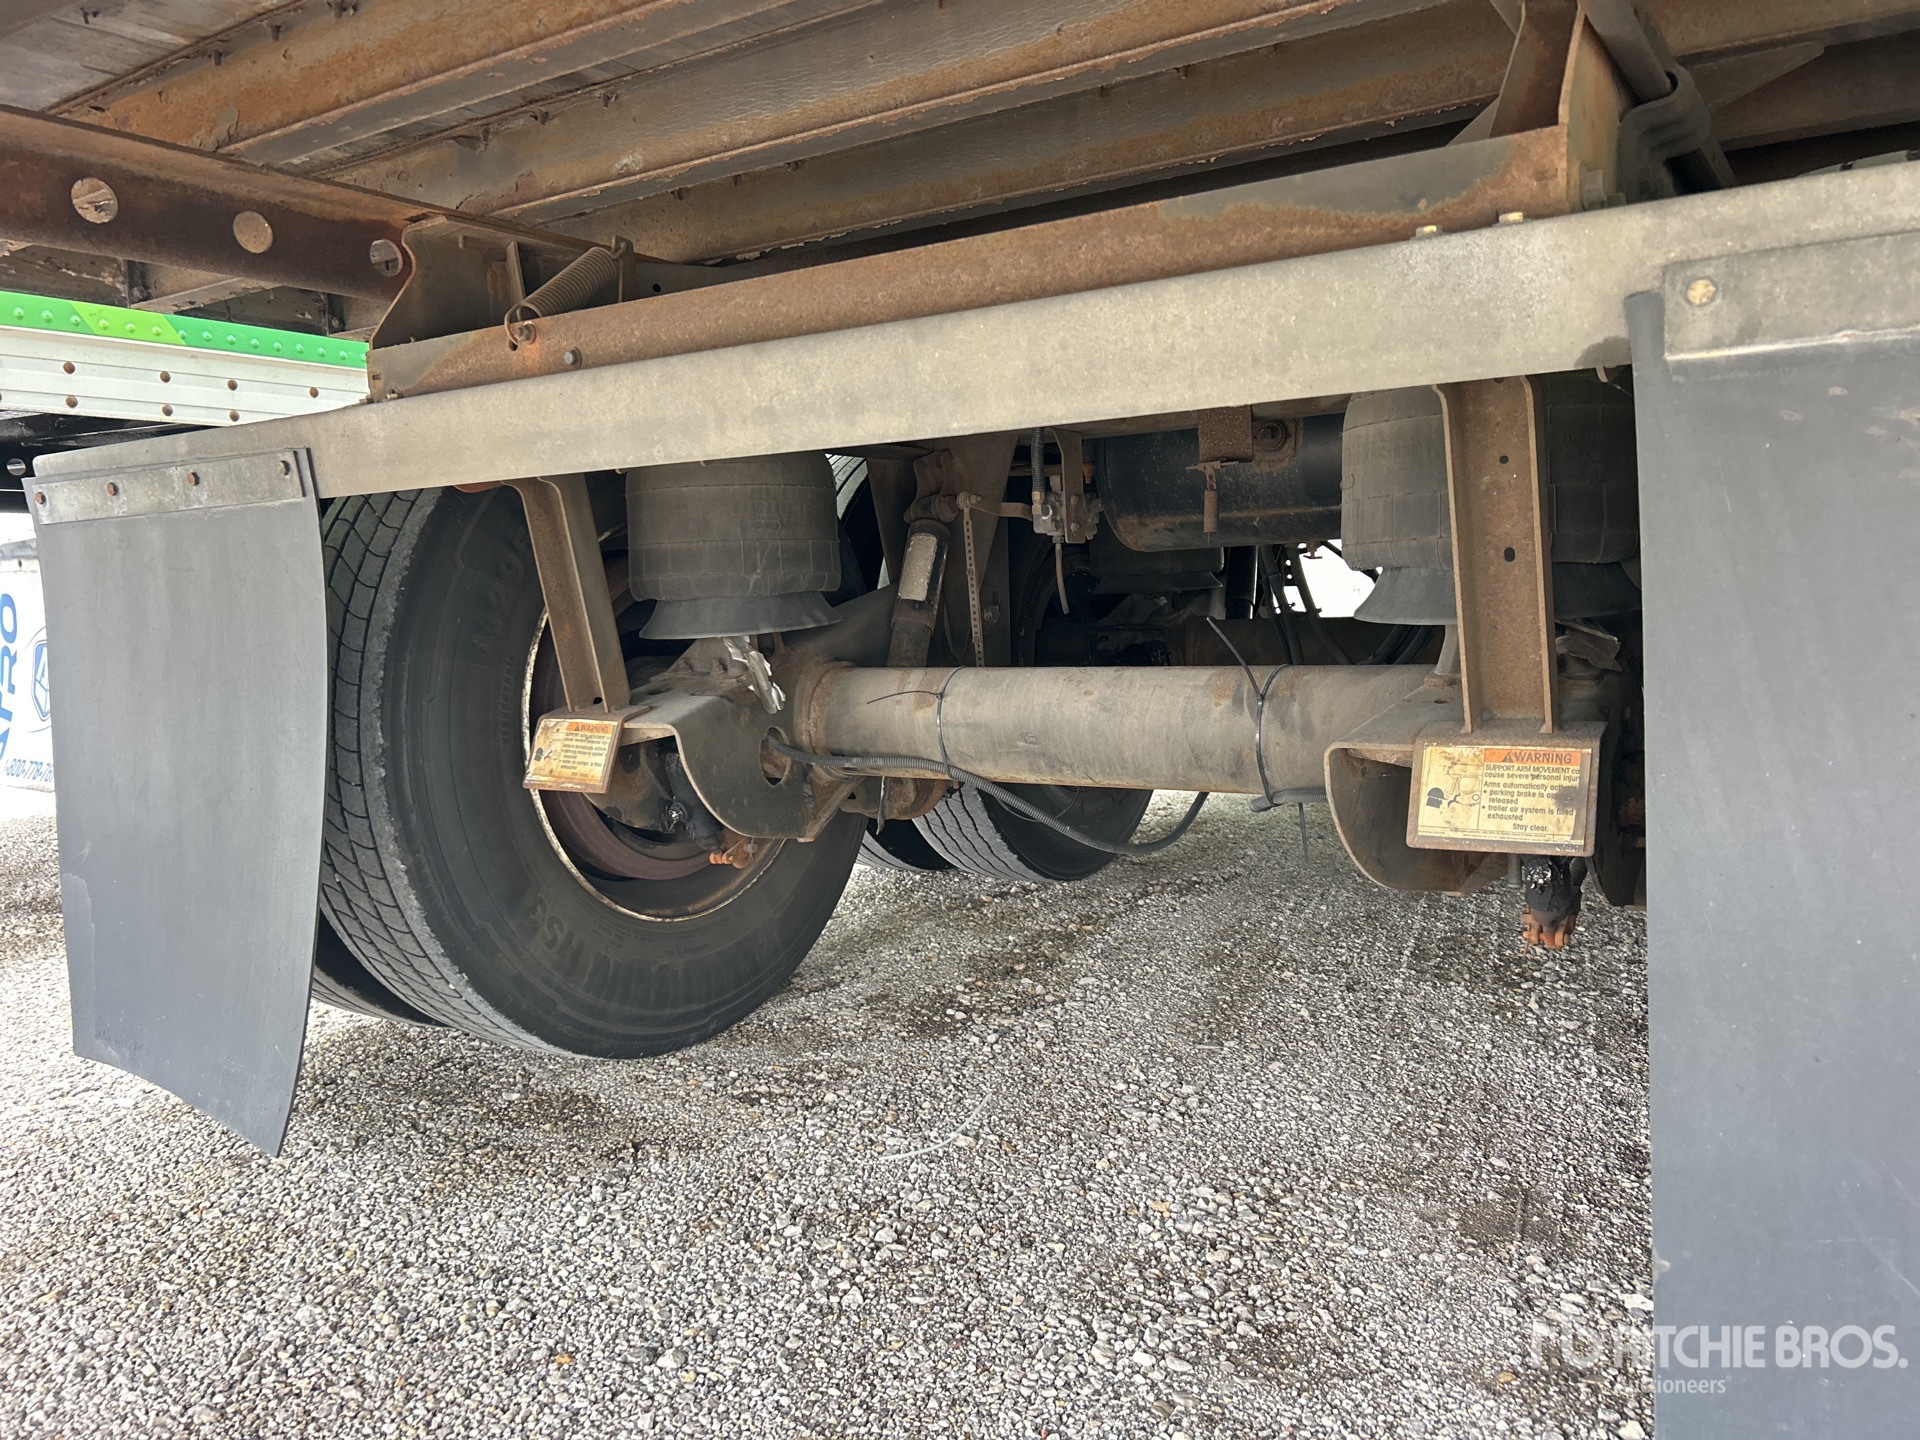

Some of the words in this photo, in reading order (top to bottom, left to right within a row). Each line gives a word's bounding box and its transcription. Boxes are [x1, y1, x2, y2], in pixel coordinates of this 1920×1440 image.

[581, 725, 608, 733] WARNING
[1514, 752, 1572, 764] WARNING
[1485, 764, 1515, 772] SUPPORT
[1532, 766, 1571, 774] MOVEMENT
[1503, 782, 1548, 791] automatically
[1512, 823, 1527, 831] Stay
[1530, 824, 1549, 832] clear.
